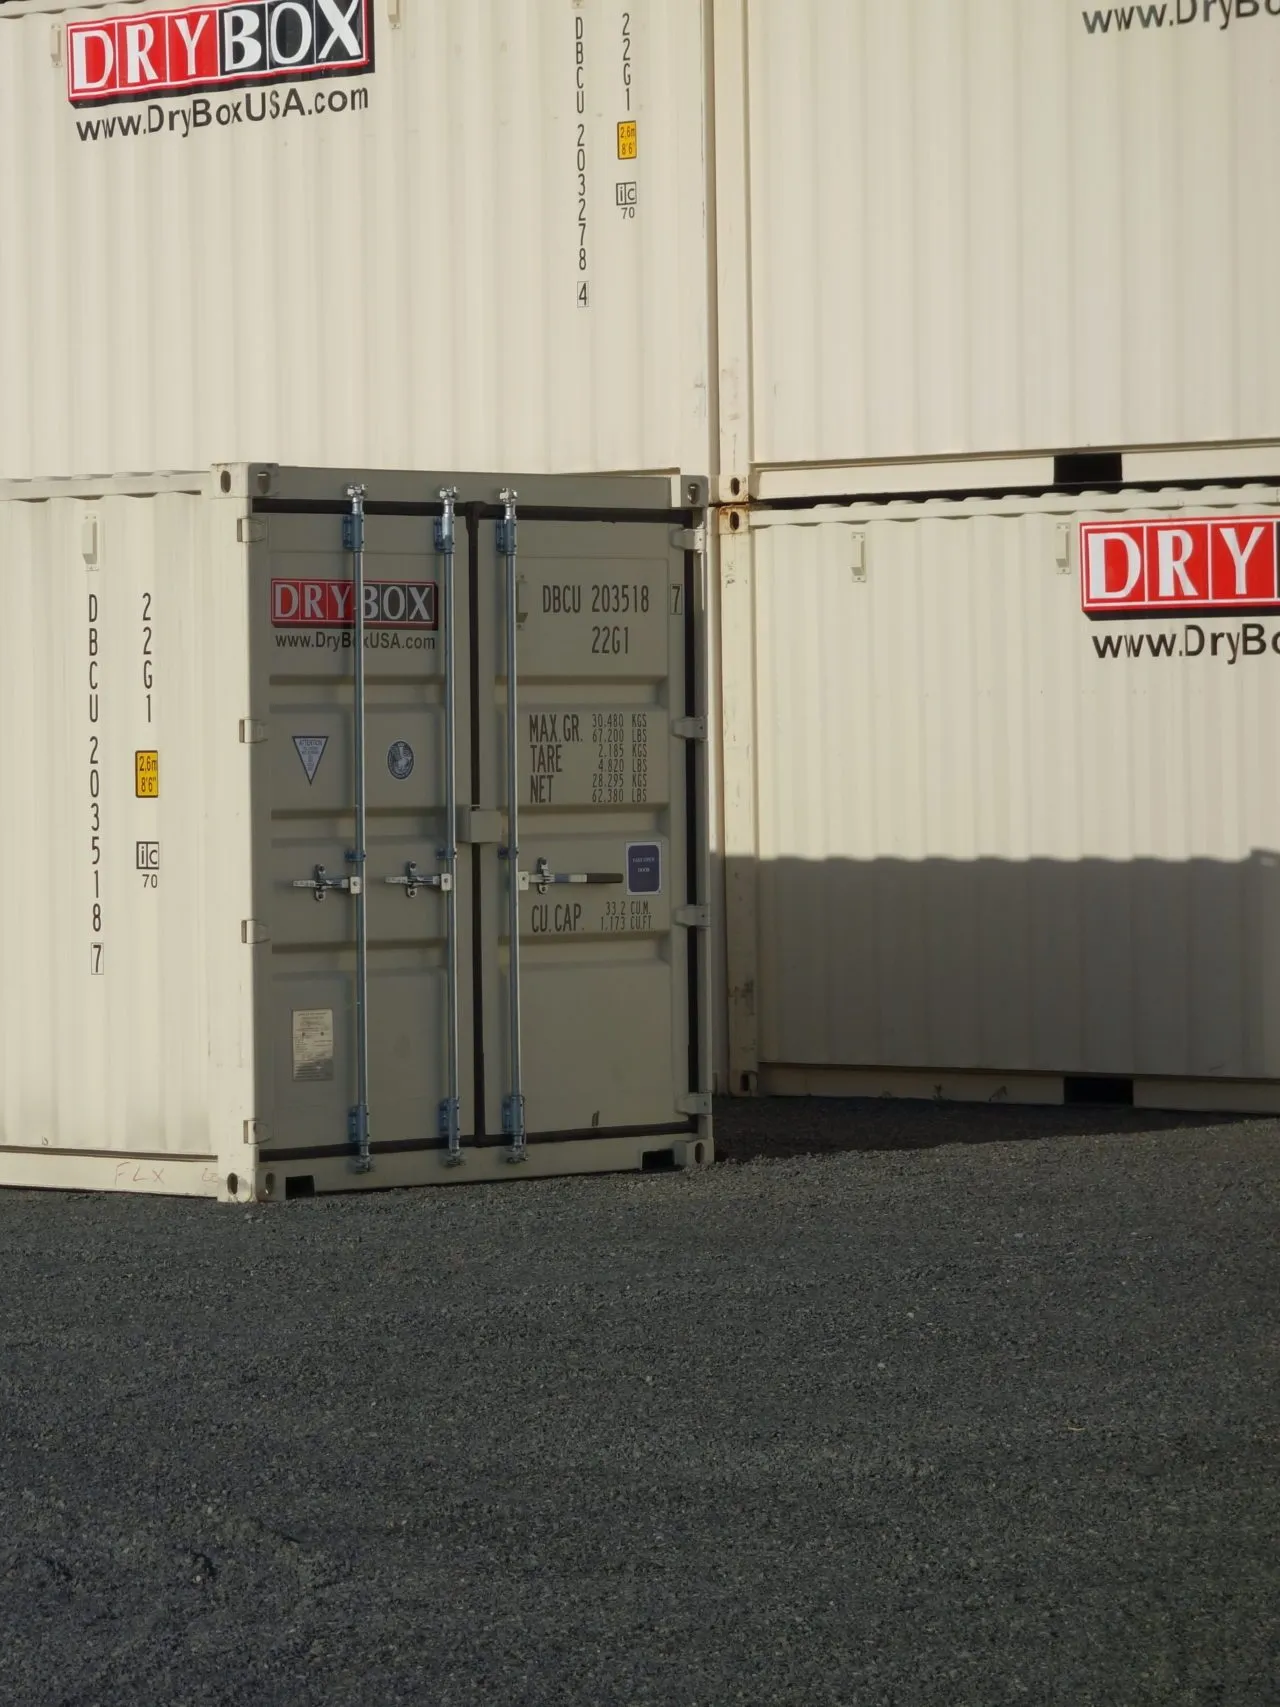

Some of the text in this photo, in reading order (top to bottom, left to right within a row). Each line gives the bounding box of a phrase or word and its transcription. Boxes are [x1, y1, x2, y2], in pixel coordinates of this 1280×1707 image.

[71, 0, 363, 90] DRYBOX
[622, 12, 631, 111] 22G1
[76, 87, 369, 142] www.DryBoxUSA.com
[575, 16, 588, 305] DBCU 203278 4
[621, 207, 635, 219] 70
[273, 583, 432, 621] DRYBOX
[542, 584, 681, 614] DBCU 203518 7
[591, 625, 629, 655] 22G1
[143, 592, 153, 723] 22G1
[631, 713, 648, 728] KGS
[631, 728, 648, 743] LBS
[529, 744, 563, 773] TARE
[631, 744, 648, 758] KGS
[631, 758, 648, 773] LBS
[88, 593, 102, 973] DBCU 203518 7
[529, 774, 555, 804] NET
[631, 773, 648, 788] KGS
[631, 788, 648, 803] LBS
[141, 873, 158, 888] 70
